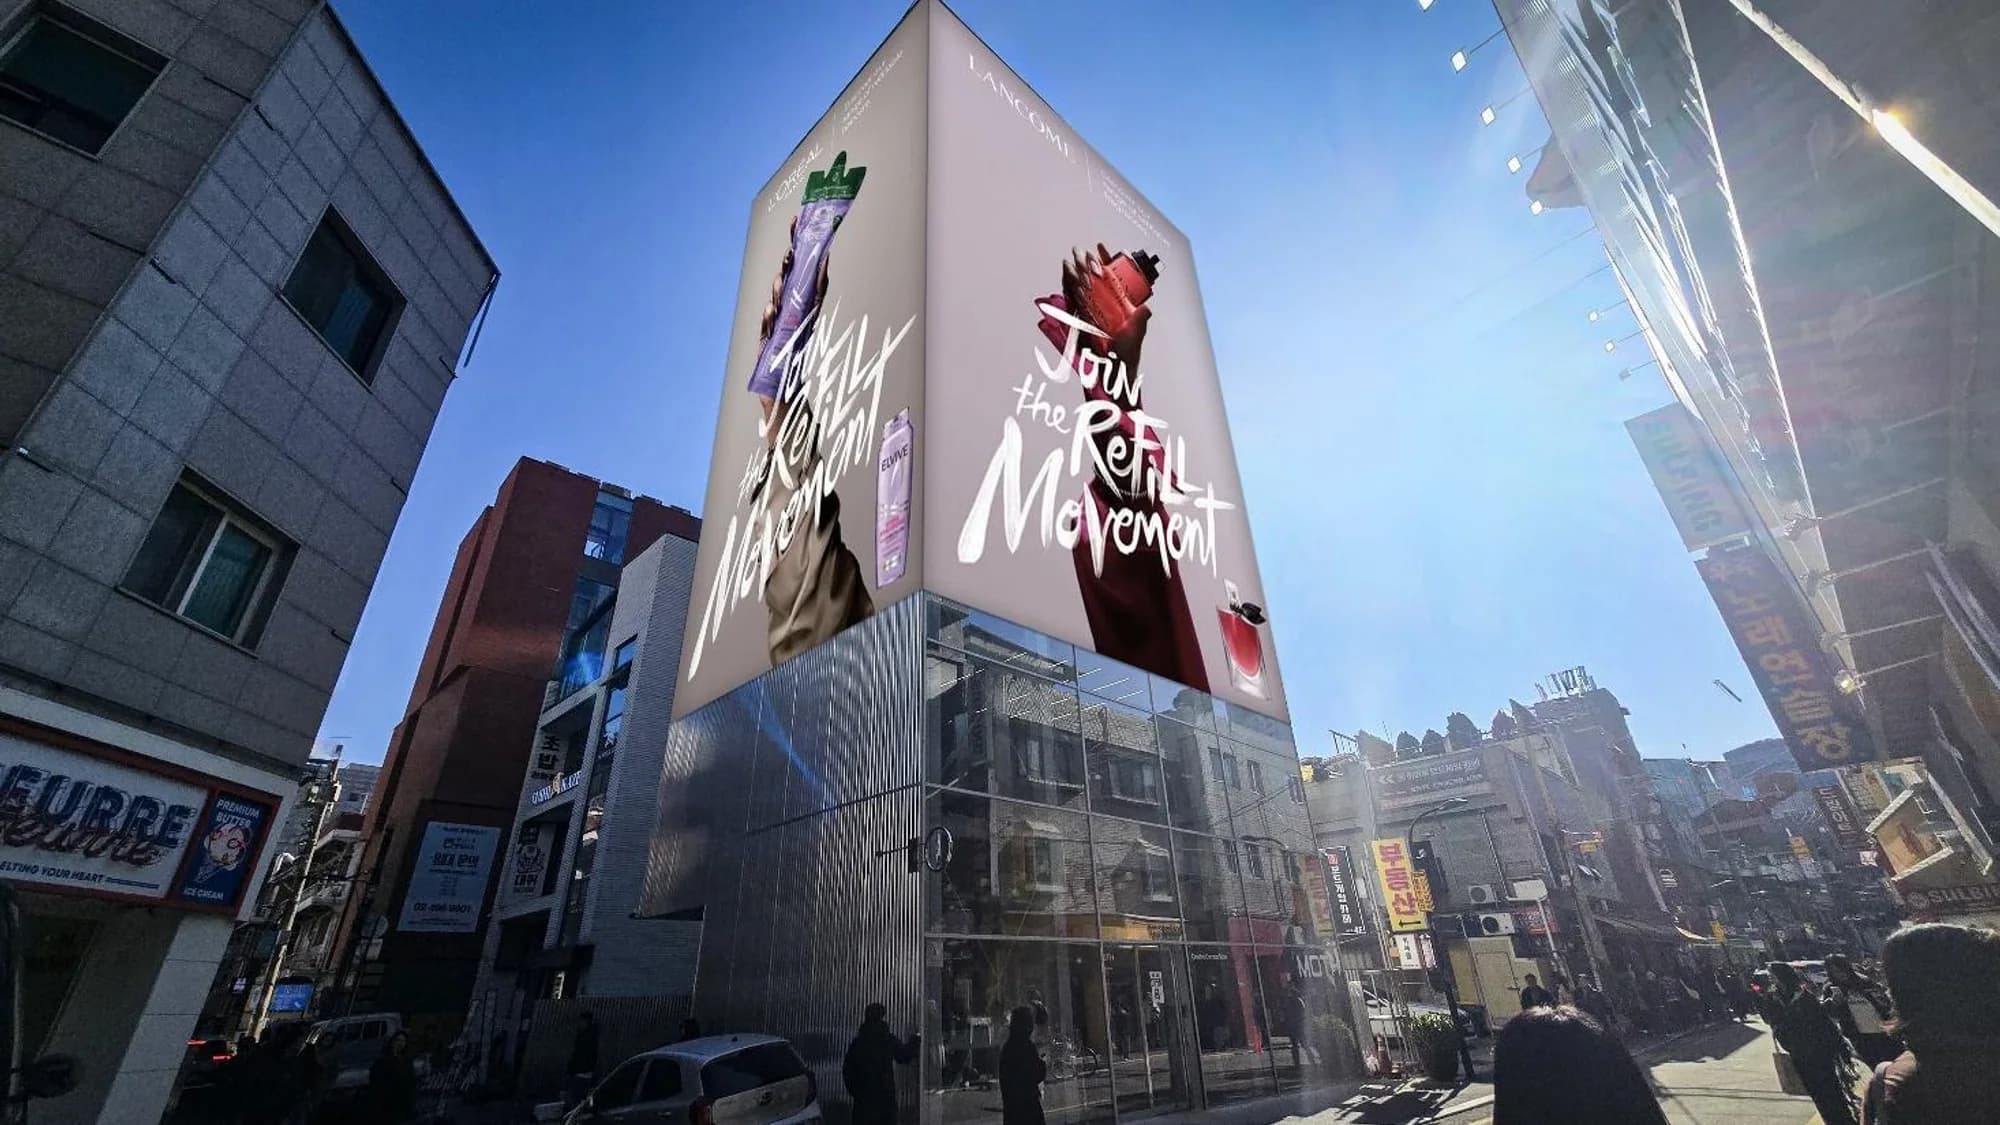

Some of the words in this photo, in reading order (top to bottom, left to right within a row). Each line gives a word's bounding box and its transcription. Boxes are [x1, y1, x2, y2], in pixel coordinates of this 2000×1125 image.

[1012, 373, 1070, 433] the
[737, 443, 772, 509] the
[881, 443, 909, 473] ELVIVE
[687, 313, 918, 683] Movement
[957, 415, 1236, 579] Movement
[0, 762, 198, 851] EURRE
[215, 799, 261, 818] PREMIUM
[215, 811, 252, 828] BUTTER
[0, 860, 40, 876] ELTING
[41, 864, 73, 882] YOUR
[72, 871, 105, 884] HEART
[183, 887, 197, 898] ICE
[1379, 843, 1417, 916] 부동산
